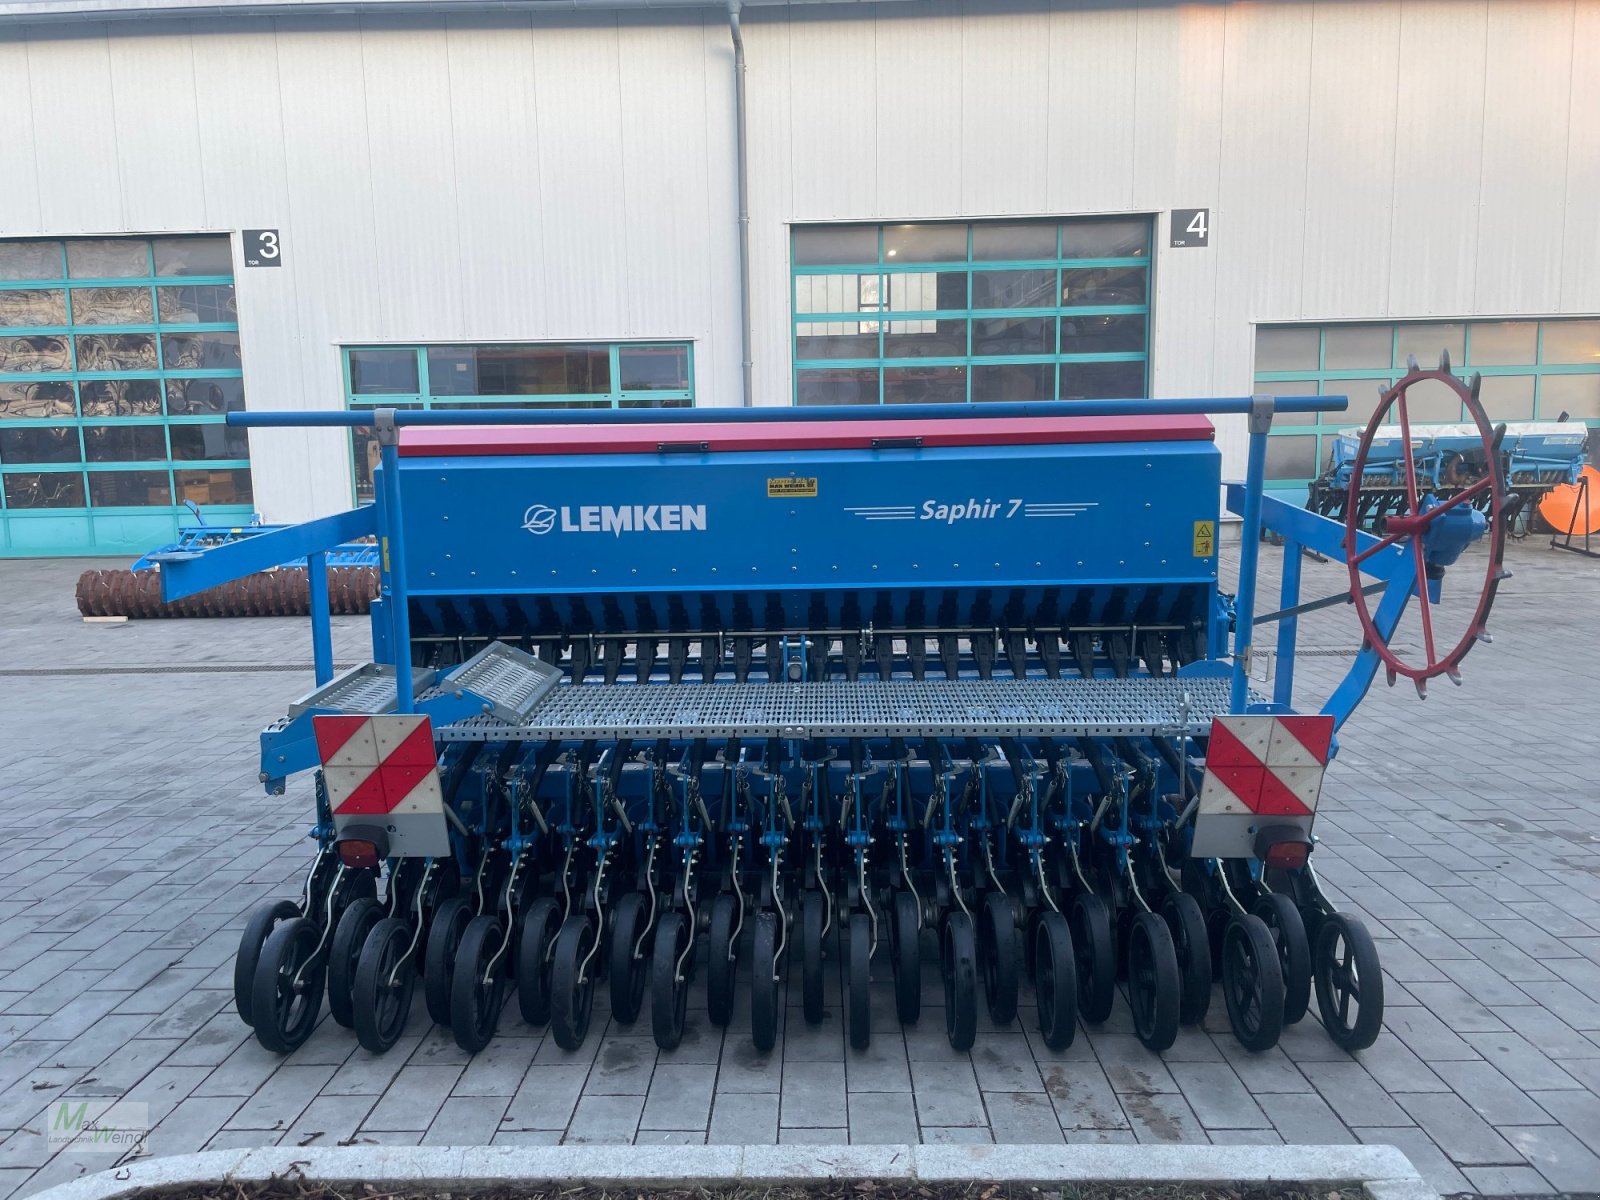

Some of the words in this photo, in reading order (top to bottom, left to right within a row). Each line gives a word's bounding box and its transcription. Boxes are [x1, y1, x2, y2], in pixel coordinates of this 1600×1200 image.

[1186, 211, 1207, 238] 4
[259, 231, 279, 258] 3
[561, 505, 707, 538] LEMKEN
[920, 498, 1001, 524] Saphir
[1006, 499, 1023, 518] 7
